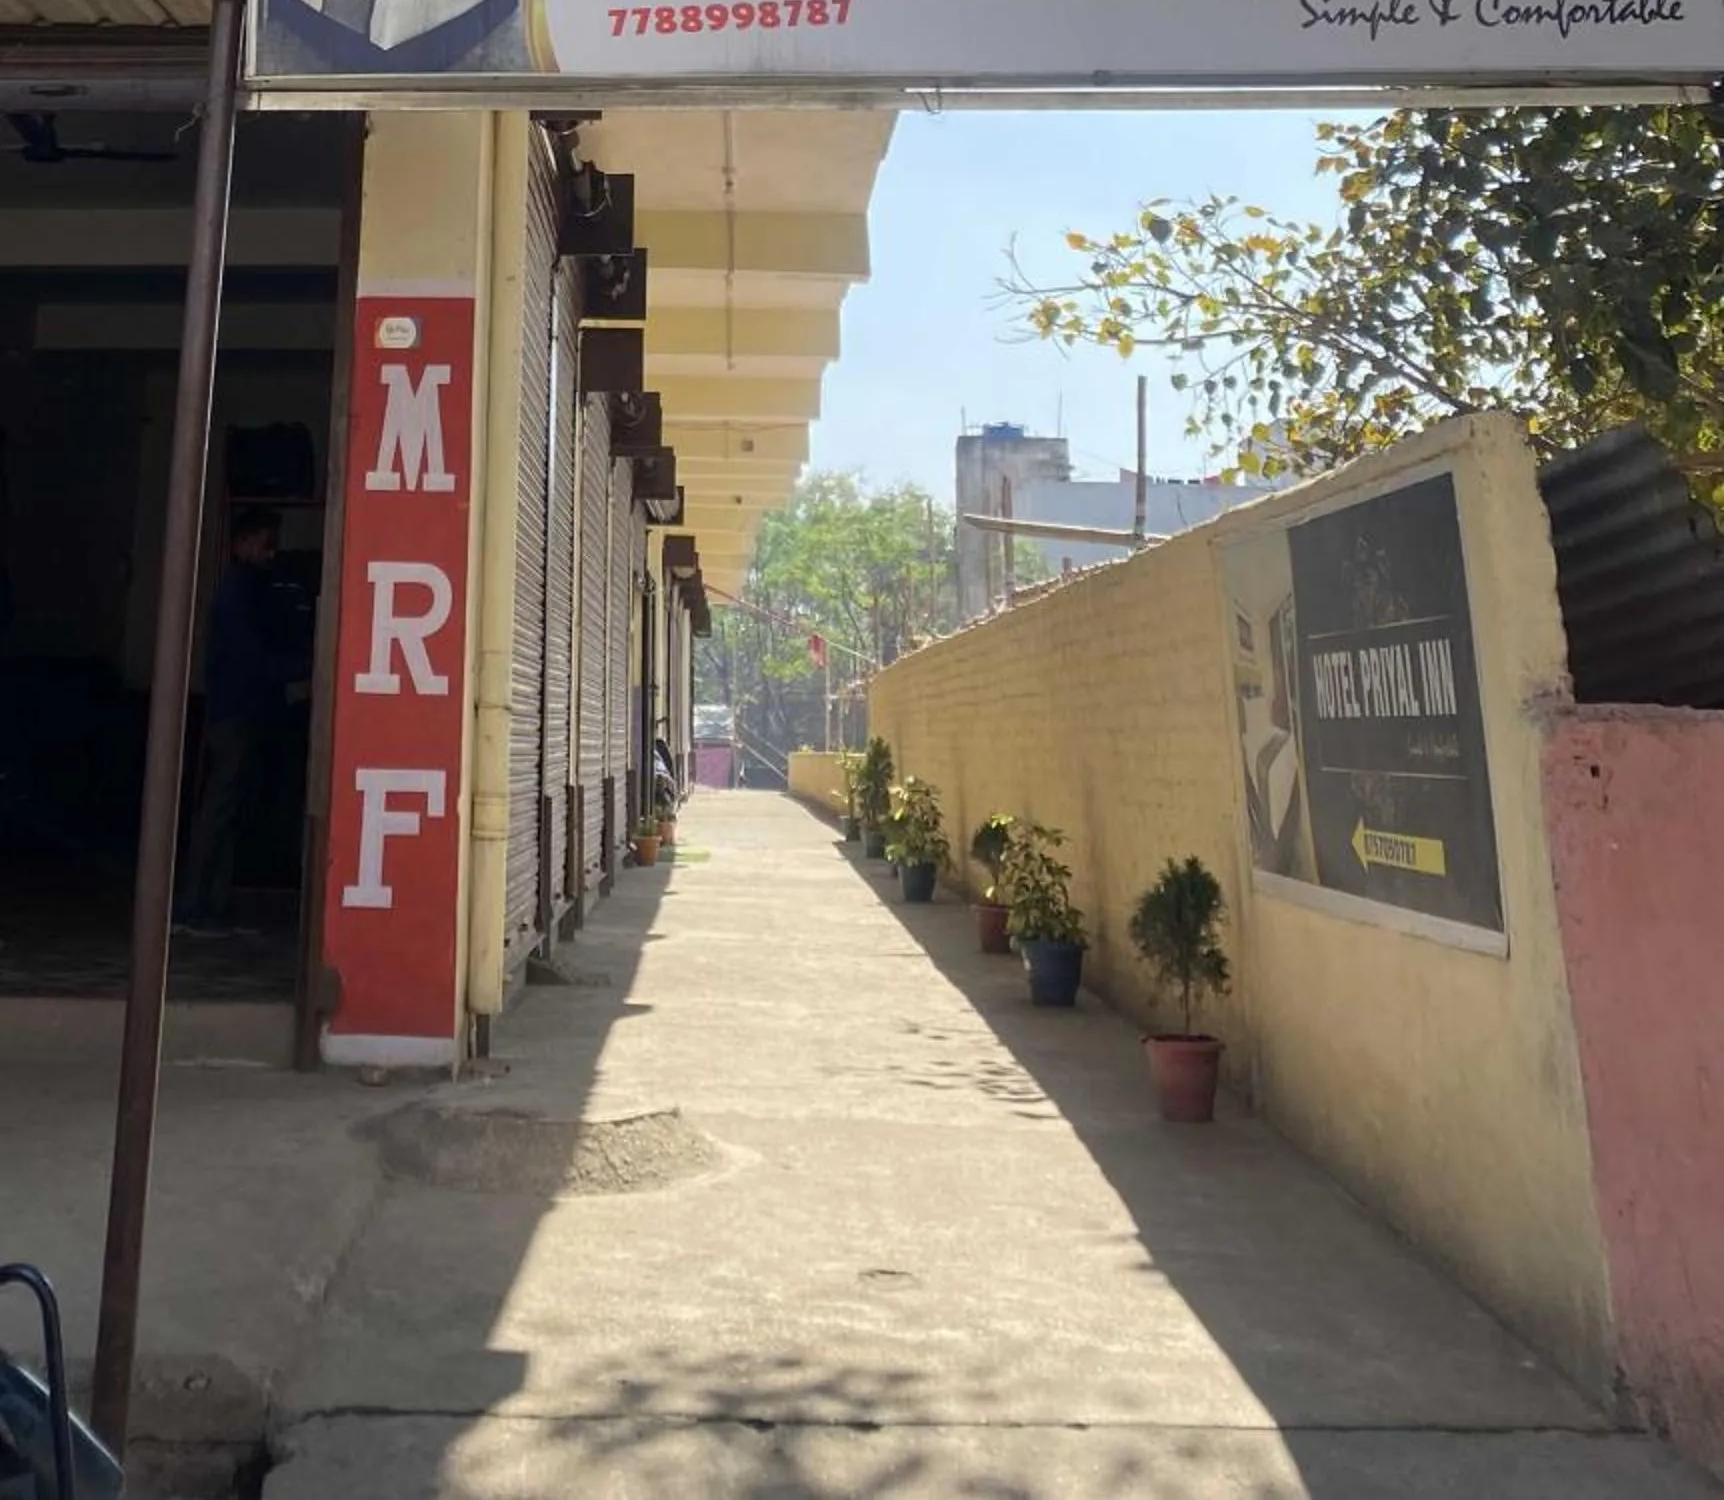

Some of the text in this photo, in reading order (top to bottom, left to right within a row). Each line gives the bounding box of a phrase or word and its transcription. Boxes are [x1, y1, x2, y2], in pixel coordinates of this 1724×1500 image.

[341, 363, 456, 911] MRF
[1312, 637, 1457, 719] HOTEL PRIYAL INN
